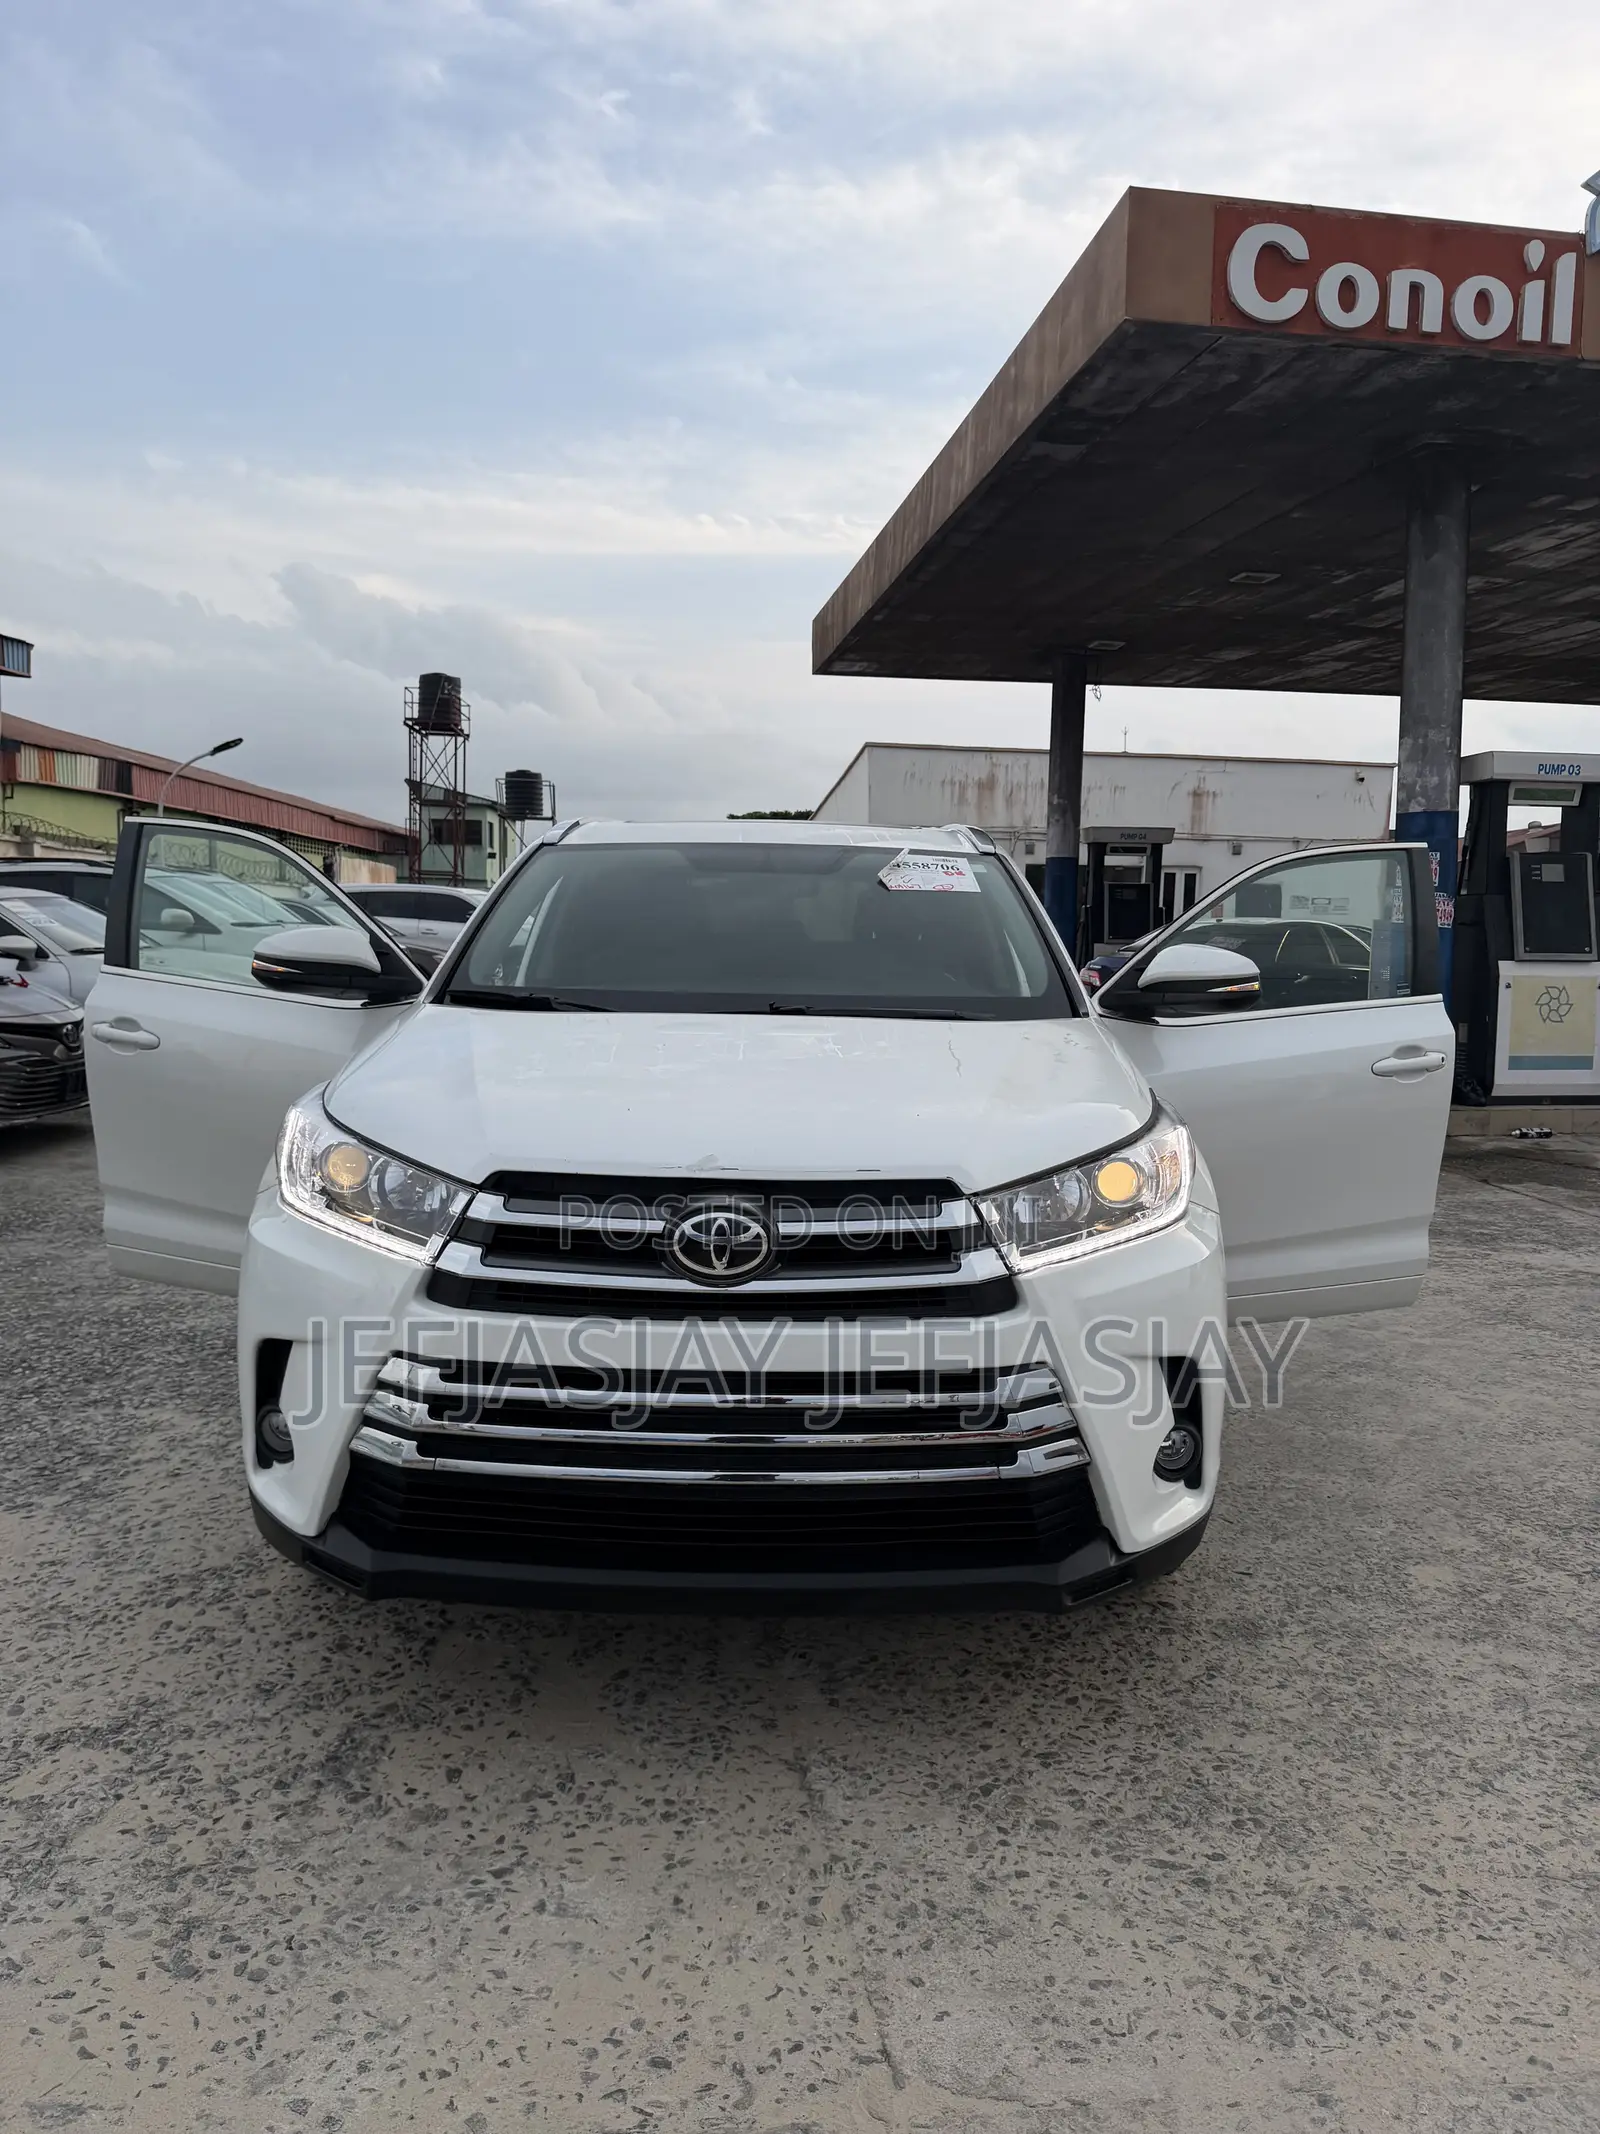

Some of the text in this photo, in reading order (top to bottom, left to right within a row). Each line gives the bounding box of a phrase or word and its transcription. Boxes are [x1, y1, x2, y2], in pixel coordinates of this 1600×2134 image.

[1227, 222, 1577, 346] Conoil
[1537, 763, 1581, 776] PUMP 03
[1120, 832, 1137, 840] PUMP
